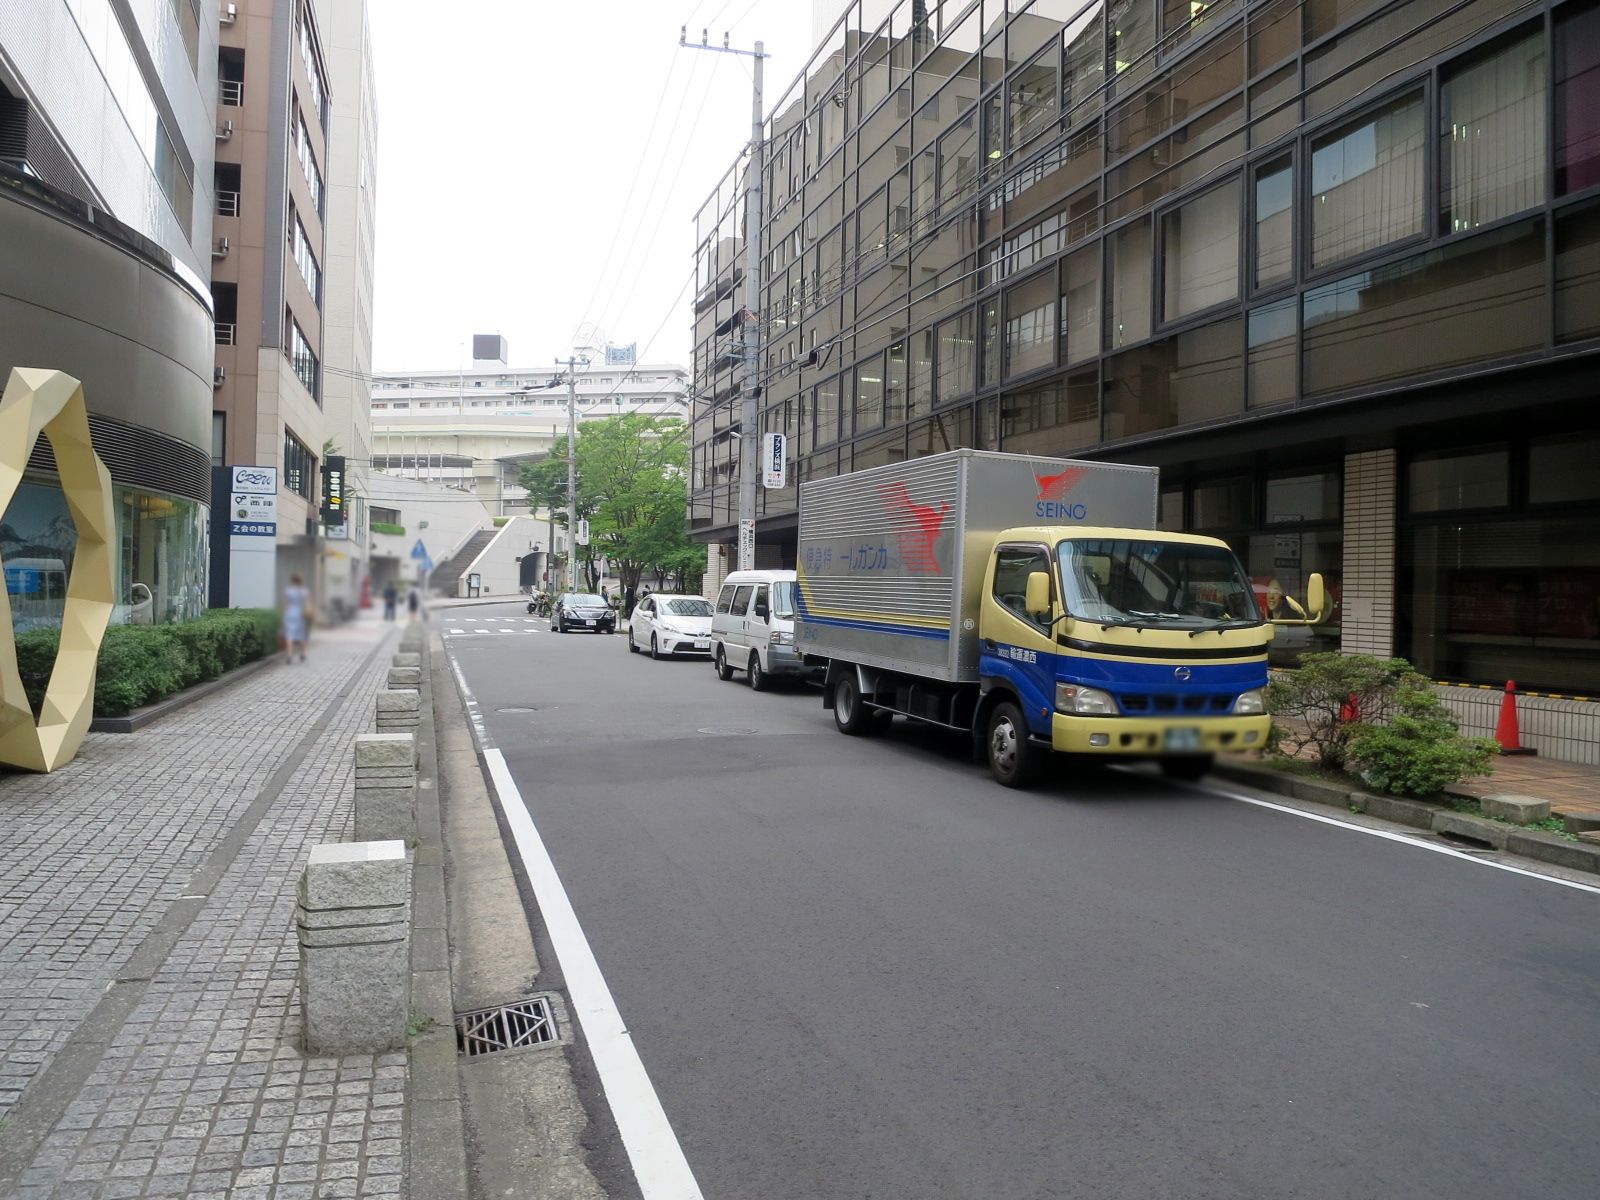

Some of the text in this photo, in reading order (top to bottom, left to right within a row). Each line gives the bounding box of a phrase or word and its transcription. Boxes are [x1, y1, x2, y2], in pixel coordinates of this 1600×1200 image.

[1035, 501, 1087, 520] SEINO
[232, 524, 274, 534] Z会の教室
